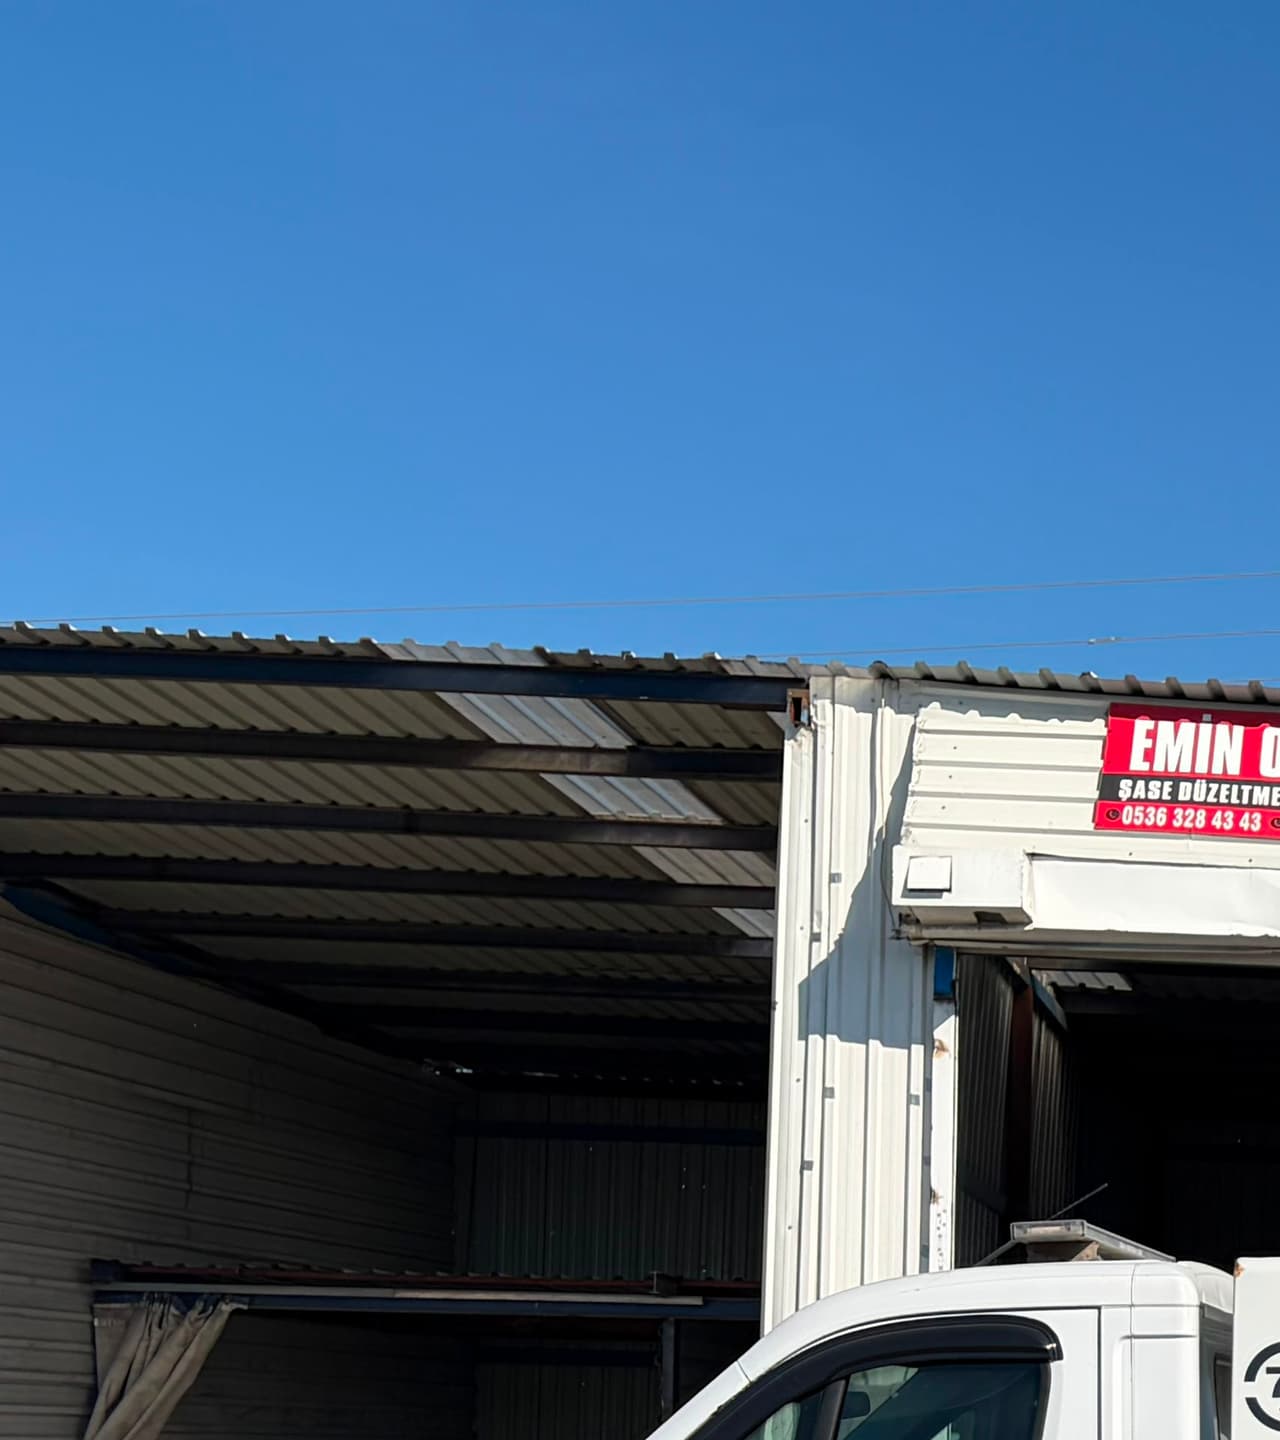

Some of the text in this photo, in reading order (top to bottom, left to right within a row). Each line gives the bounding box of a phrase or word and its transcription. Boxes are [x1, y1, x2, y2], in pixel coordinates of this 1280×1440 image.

[1118, 779, 1173, 802] ŞASE
[1121, 805, 1167, 826] 0536
[1173, 807, 1206, 828] 328
[1211, 809, 1234, 830] 43
[1239, 811, 1262, 832] 43
